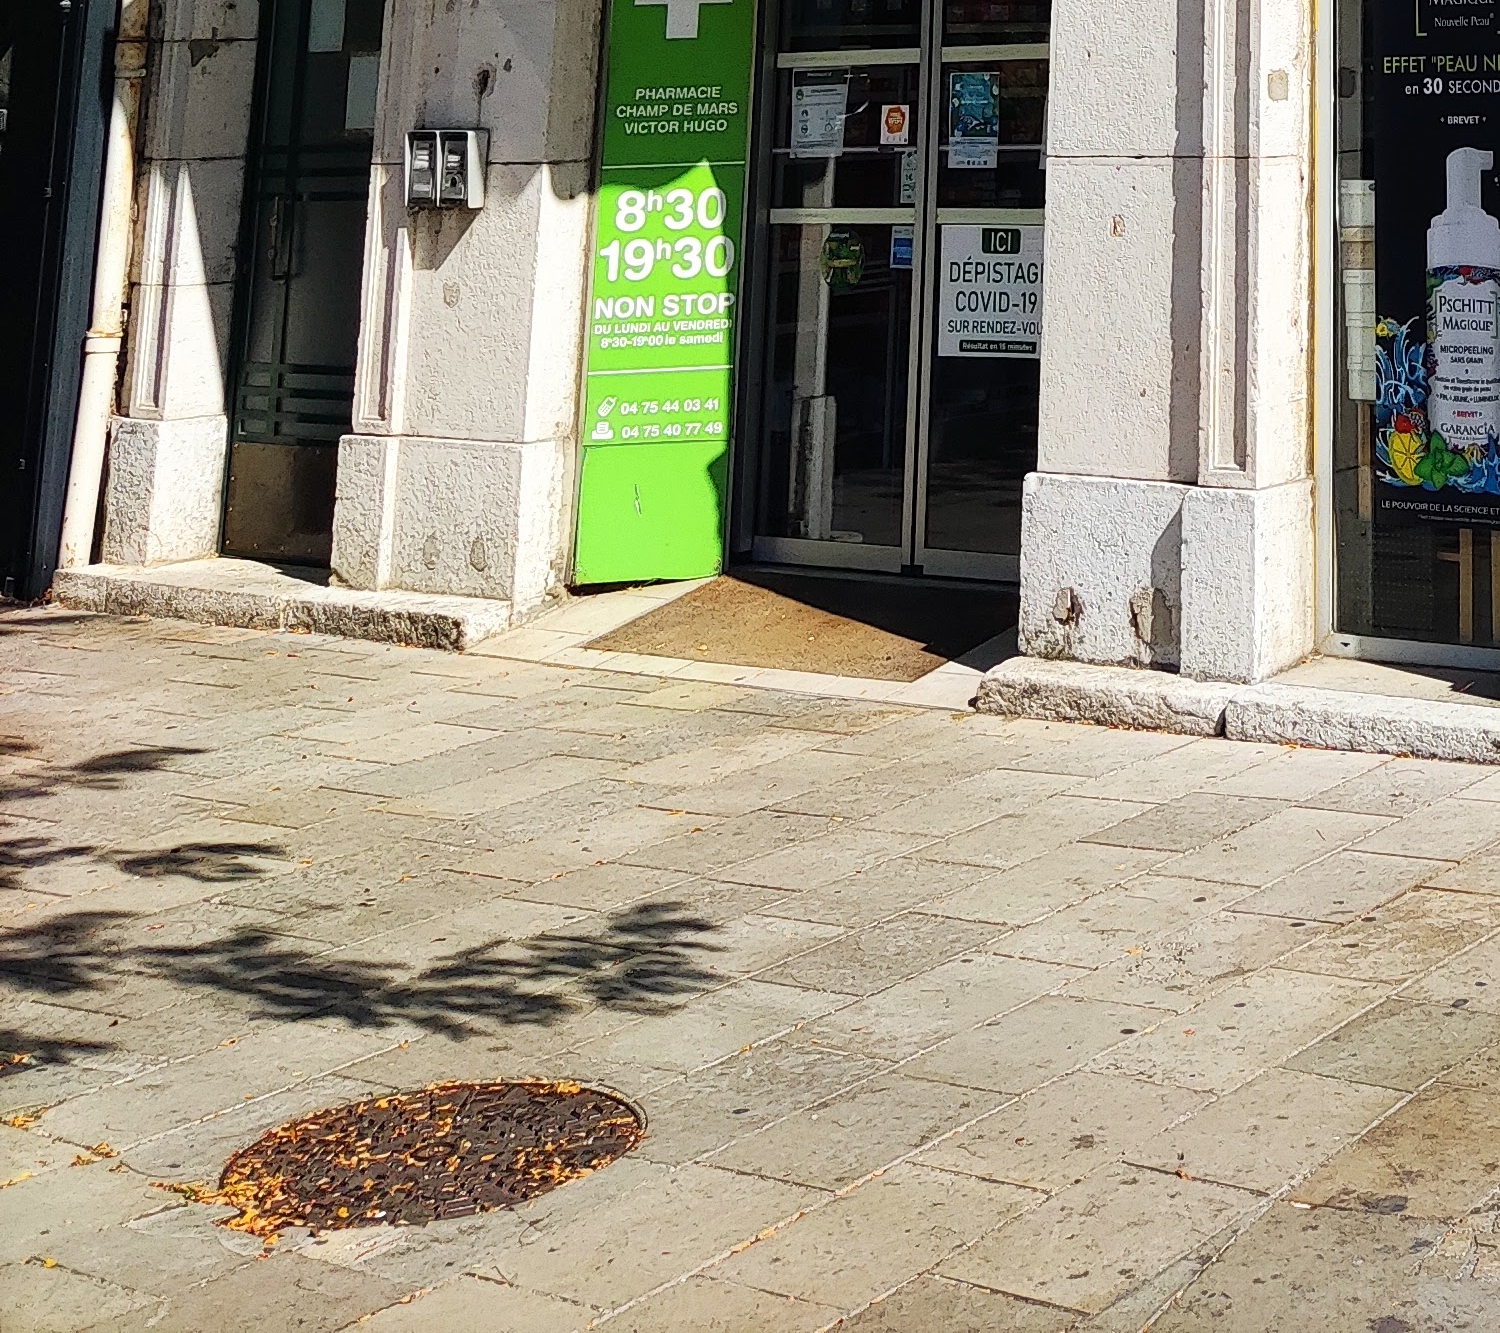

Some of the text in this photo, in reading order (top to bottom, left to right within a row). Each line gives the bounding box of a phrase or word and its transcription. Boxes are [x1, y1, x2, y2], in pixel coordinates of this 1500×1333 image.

[1434, 16, 1469, 27] Nouvelle
[1383, 56, 1426, 74] EFFET
[635, 86, 722, 101] PHARMACIE
[1405, 85, 1419, 95] en
[1423, 77, 1443, 94] 30
[616, 102, 738, 118] CHAMP DE MARS
[624, 119, 728, 134] VICTOR HUGO
[1447, 116, 1480, 124] BREVET
[615, 187, 727, 232] 8h30
[990, 231, 1012, 252] ICI
[600, 235, 735, 282] 19h30
[949, 255, 1044, 284] DÉPISTAG
[595, 292, 735, 320] NON STOP
[955, 290, 1038, 314] COVID-19
[1439, 295, 1494, 314] PSCHITT
[594, 318, 732, 335] DU LUNDI AU VENDREDI
[947, 320, 1043, 335] SUR RENDEZ-VOU
[679, 332, 723, 345] samedi
[1439, 344, 1493, 355] MICROPEELING
[620, 397, 720, 415] 04 75 44 03 41
[621, 421, 723, 439] 04 75 40 77 49
[1440, 422, 1495, 435] GARANCIA
[1381, 499, 1391, 508] LE
[1391, 501, 1428, 511] POUVOIR
[1429, 503, 1440, 511] DE
[1442, 504, 1452, 513] LA
[1454, 505, 1489, 515] SCIENCE
[1490, 507, 1500, 515] ET
